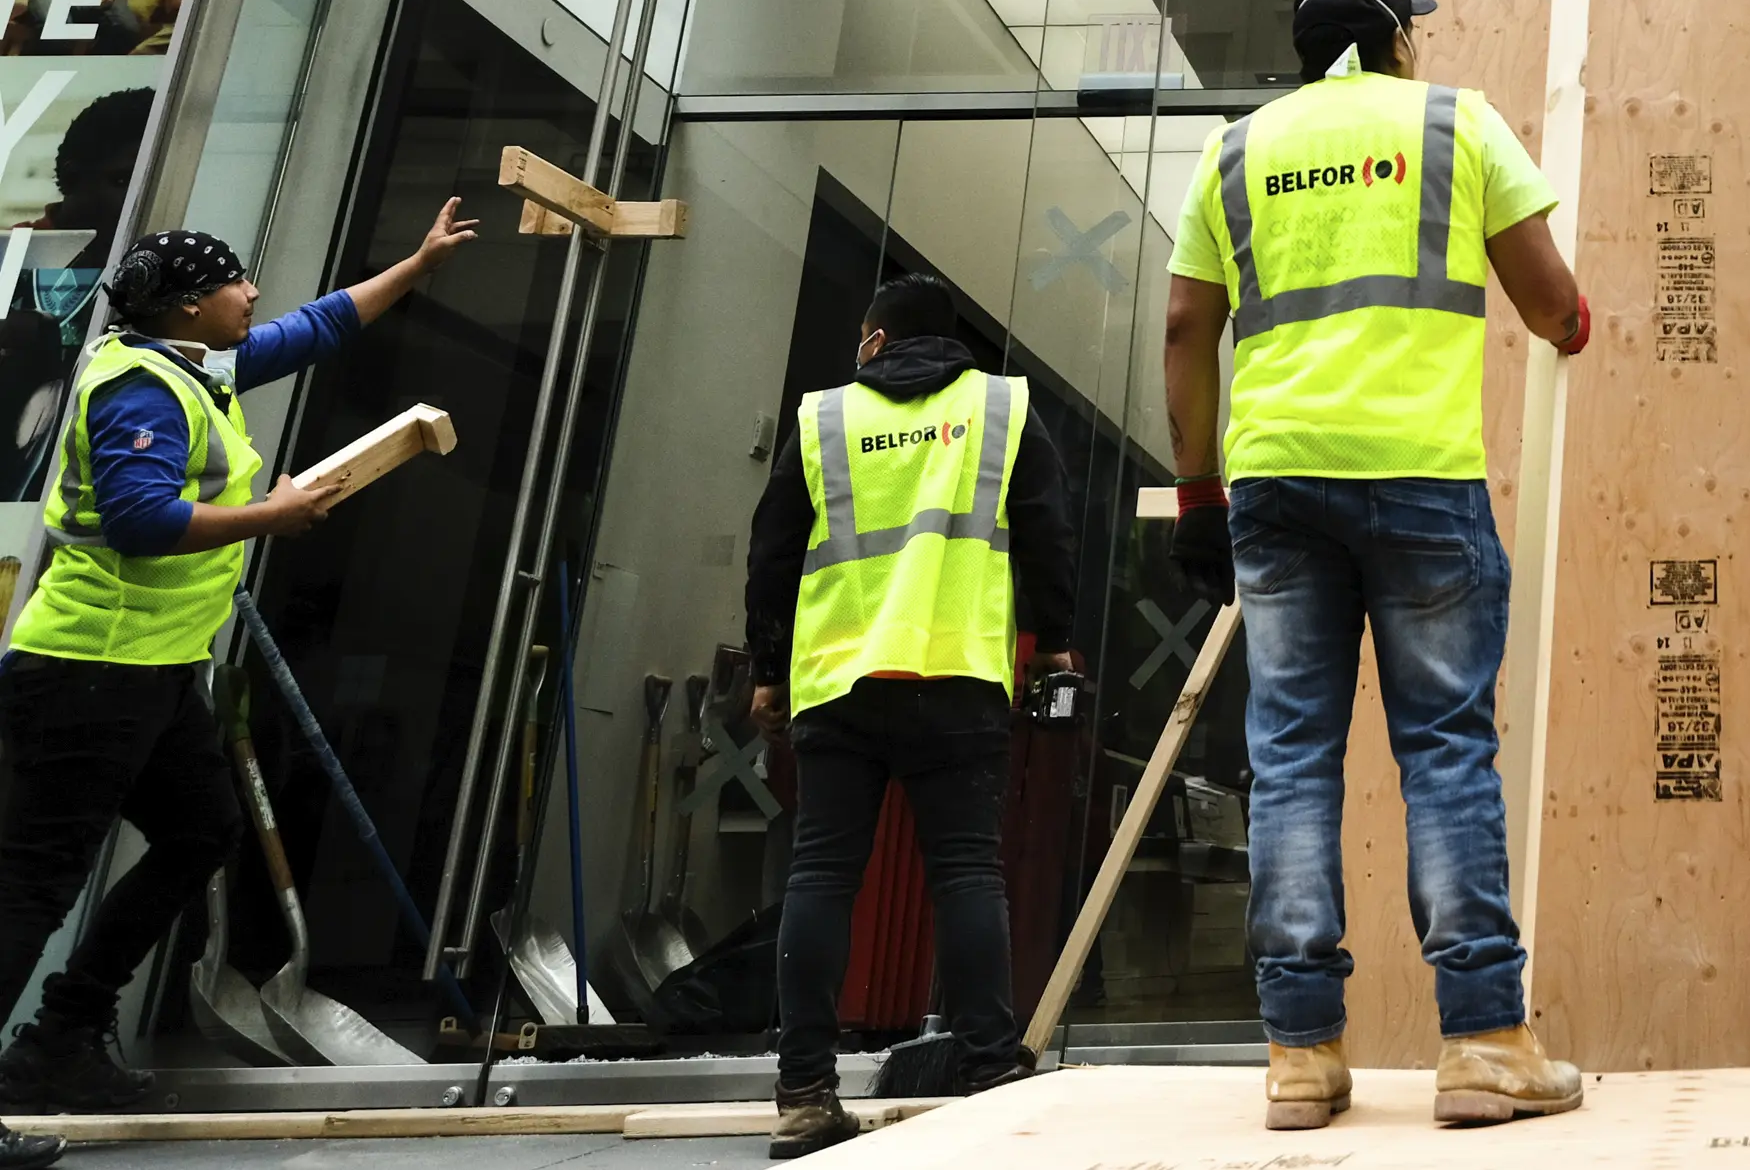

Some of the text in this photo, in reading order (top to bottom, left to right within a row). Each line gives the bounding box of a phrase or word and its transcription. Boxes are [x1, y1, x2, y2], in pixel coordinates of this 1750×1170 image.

[1265, 163, 1355, 197] BELFOR
[1662, 322, 1709, 336] APA
[861, 425, 937, 454] BELFOR
[1656, 636, 1670, 649] 14
[1662, 753, 1714, 769] APA
